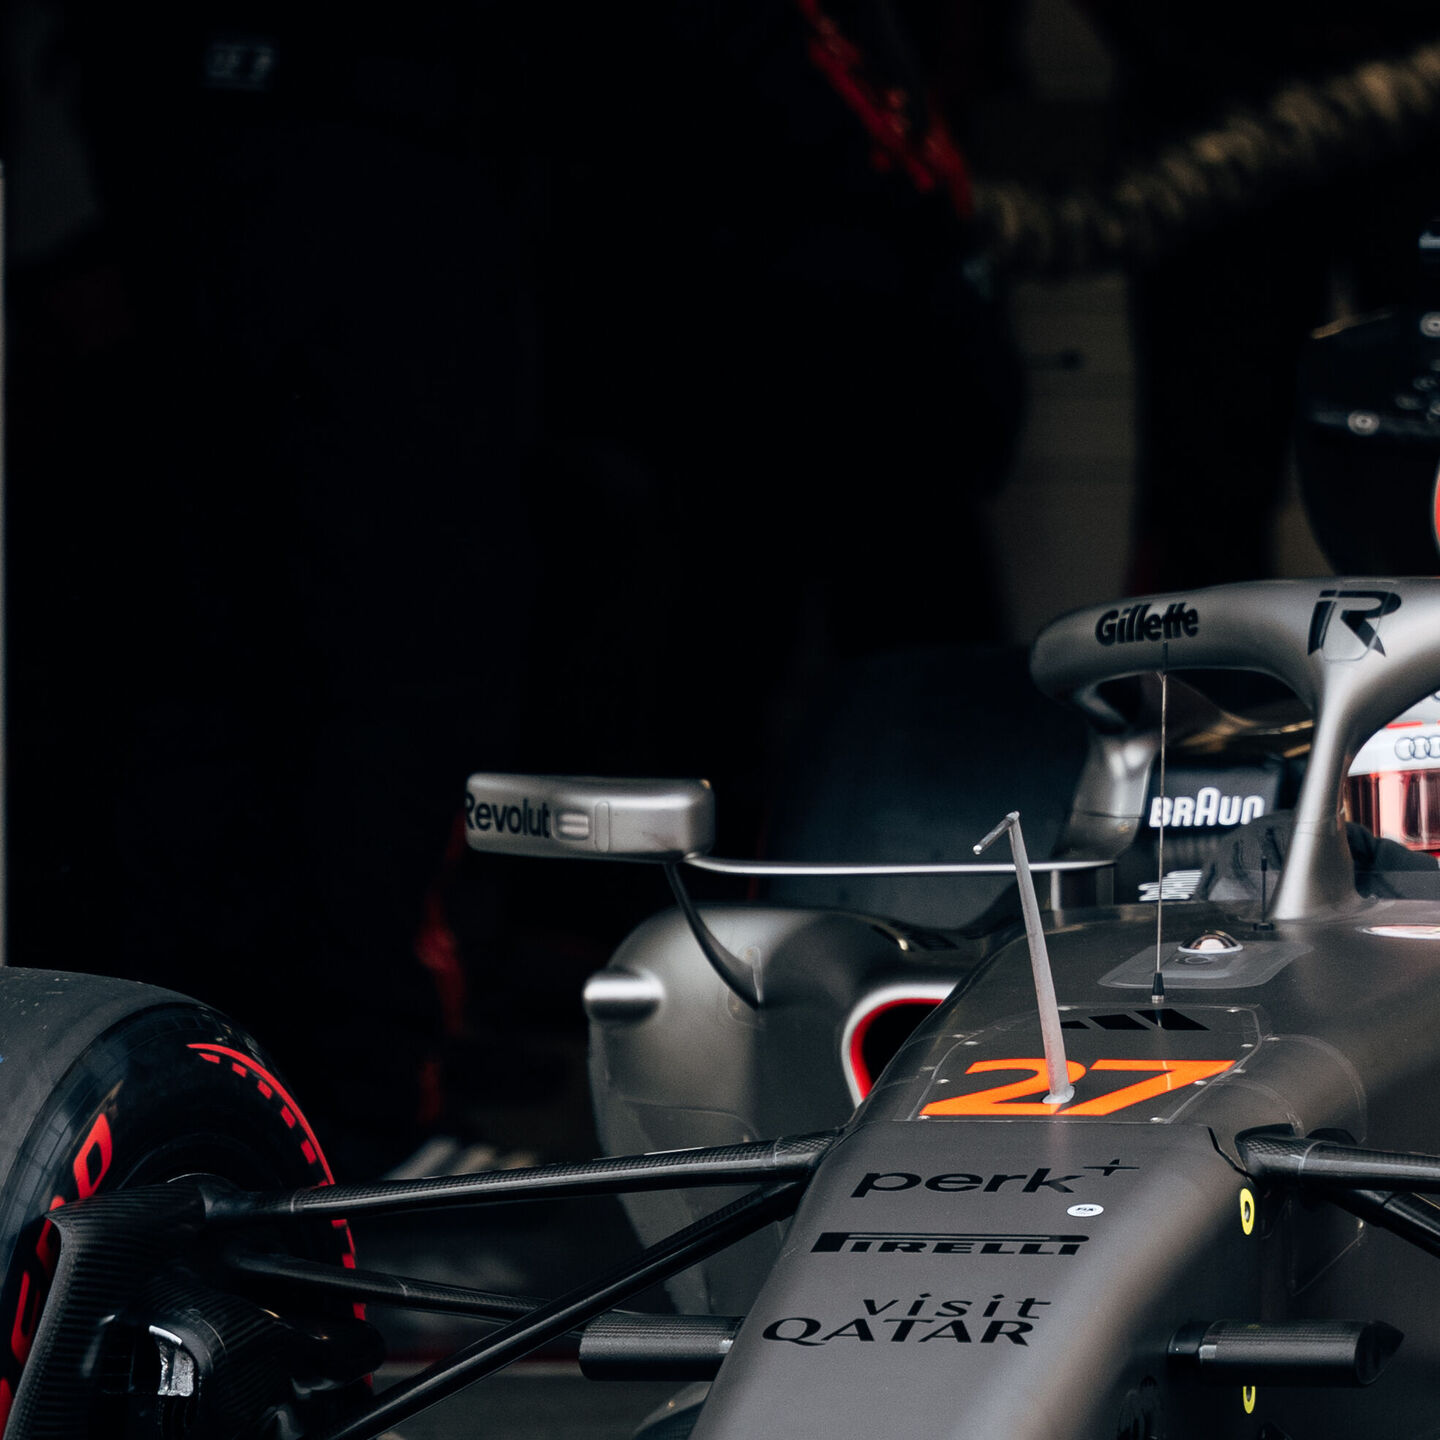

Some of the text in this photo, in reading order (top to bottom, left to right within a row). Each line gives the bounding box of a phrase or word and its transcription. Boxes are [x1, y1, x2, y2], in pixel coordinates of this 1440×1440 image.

[1095, 602, 1199, 646] Gillette
[465, 793, 550, 839] Revolut
[1149, 786, 1265, 828] BRAUN
[920, 1058, 1236, 1116] 27
[810, 1232, 1089, 1255] PIRELLI
[863, 1292, 1051, 1318] visit
[762, 1317, 1035, 1347] QATAR
